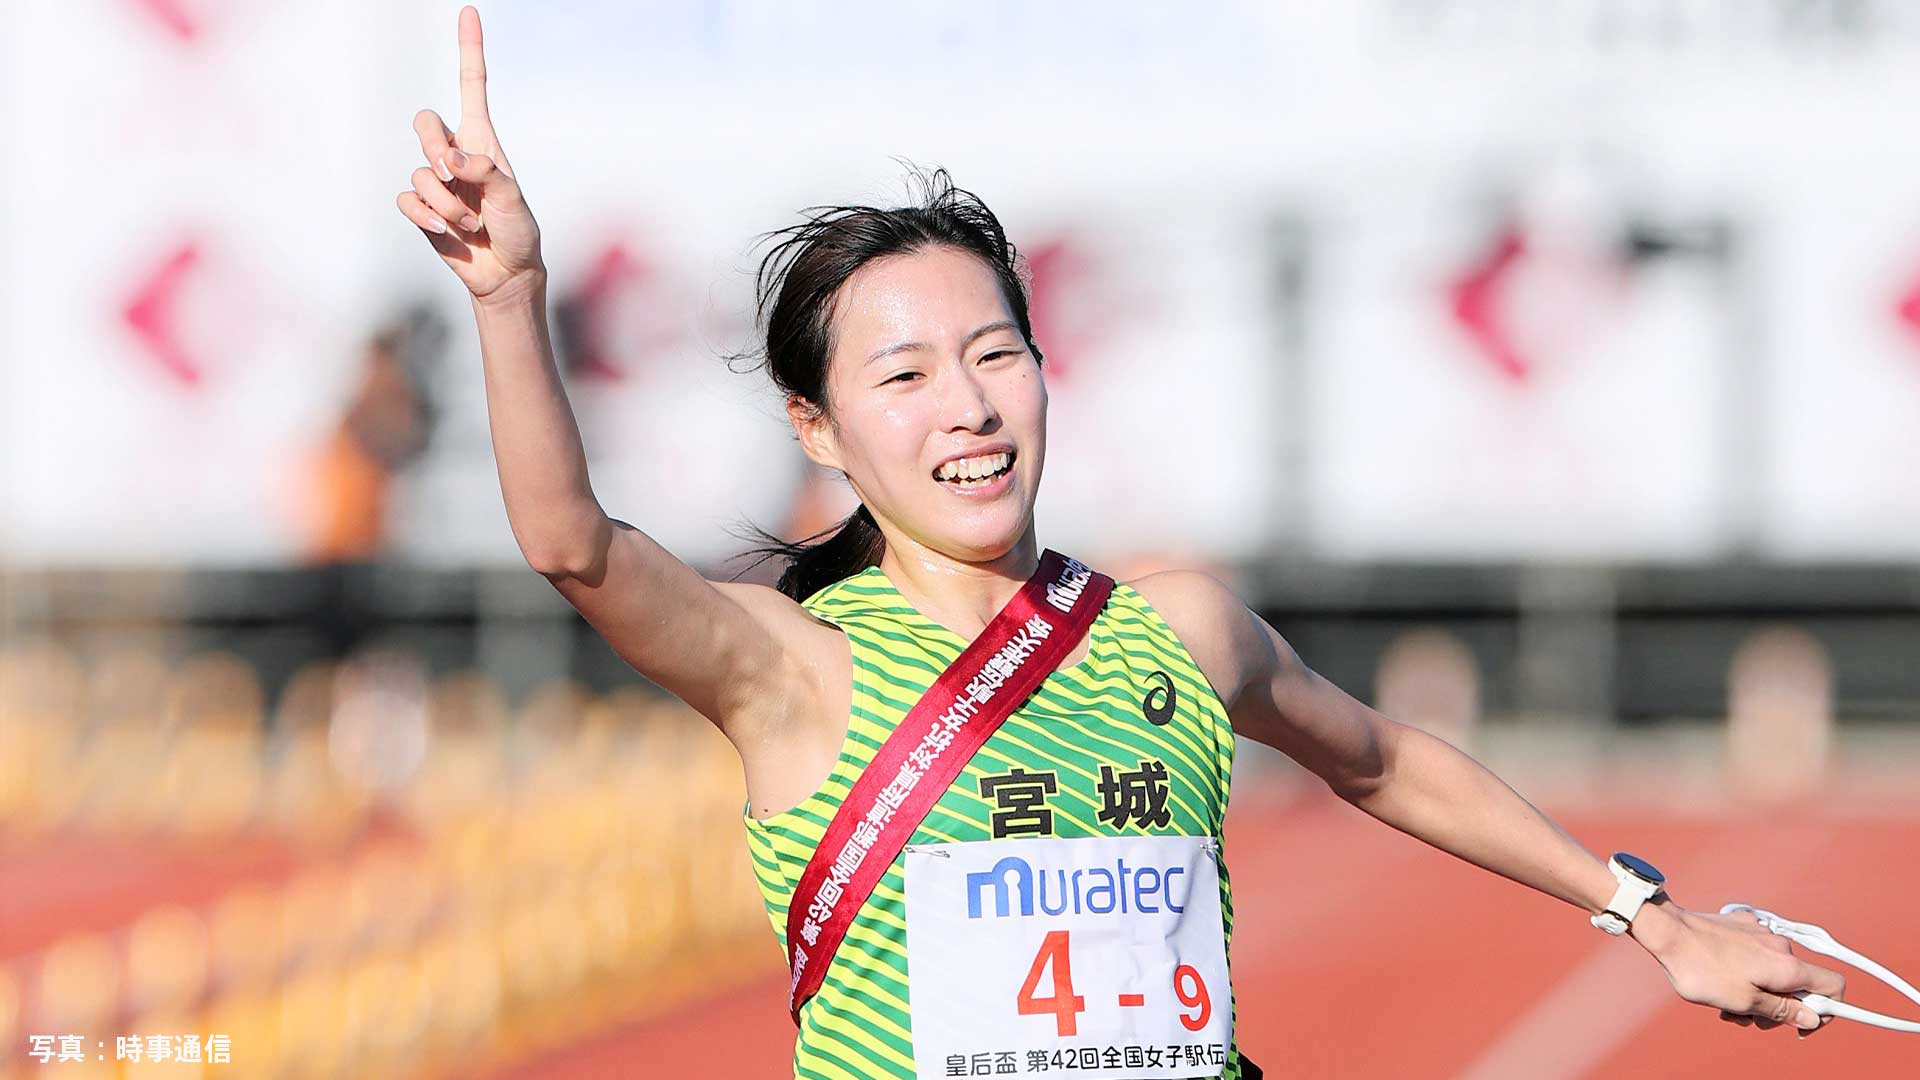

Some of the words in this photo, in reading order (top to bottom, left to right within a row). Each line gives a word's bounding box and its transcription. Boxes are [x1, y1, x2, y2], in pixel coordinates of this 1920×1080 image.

[980, 760, 1172, 839] 宮城
[946, 1051, 1018, 1077] 皇后盃
[1026, 1043, 1225, 1074] 第42回全国女子駅伝
